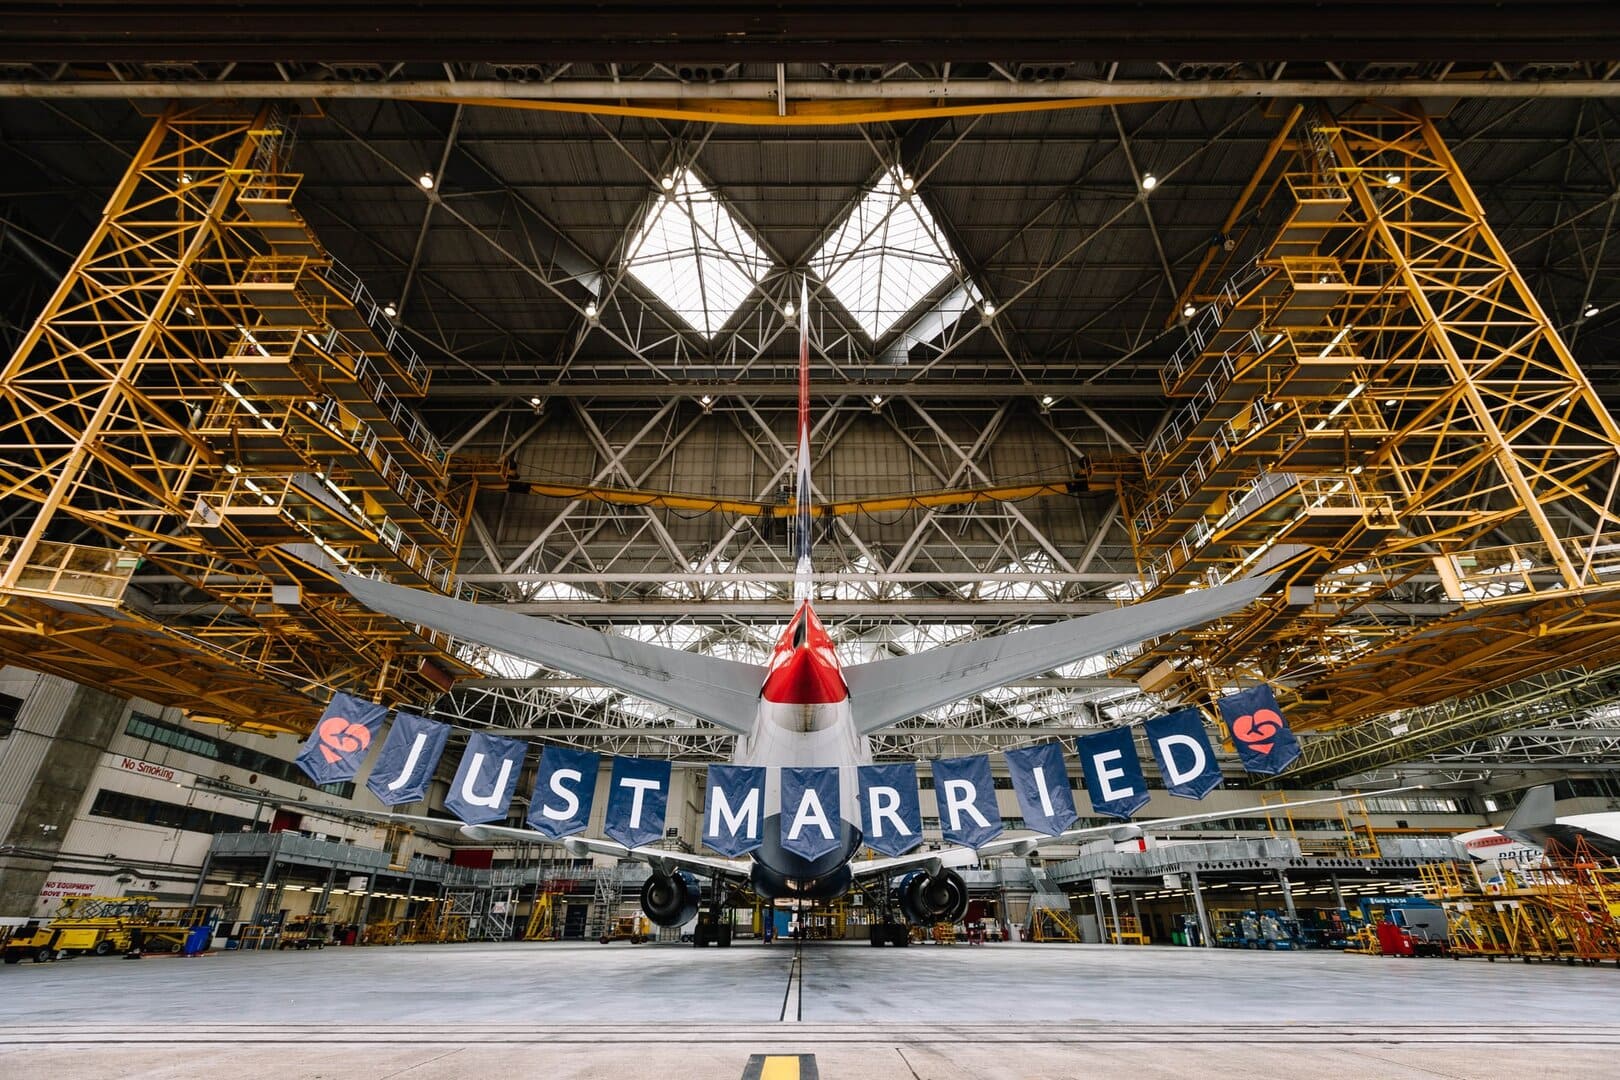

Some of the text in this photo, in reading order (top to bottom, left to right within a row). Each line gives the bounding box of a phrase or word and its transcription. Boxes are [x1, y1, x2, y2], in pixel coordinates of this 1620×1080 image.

[121, 758, 175, 781] No Smoking
[388, 733, 1207, 840] JUST MARRIED
[57, 882, 96, 890] EQUIPMENT
